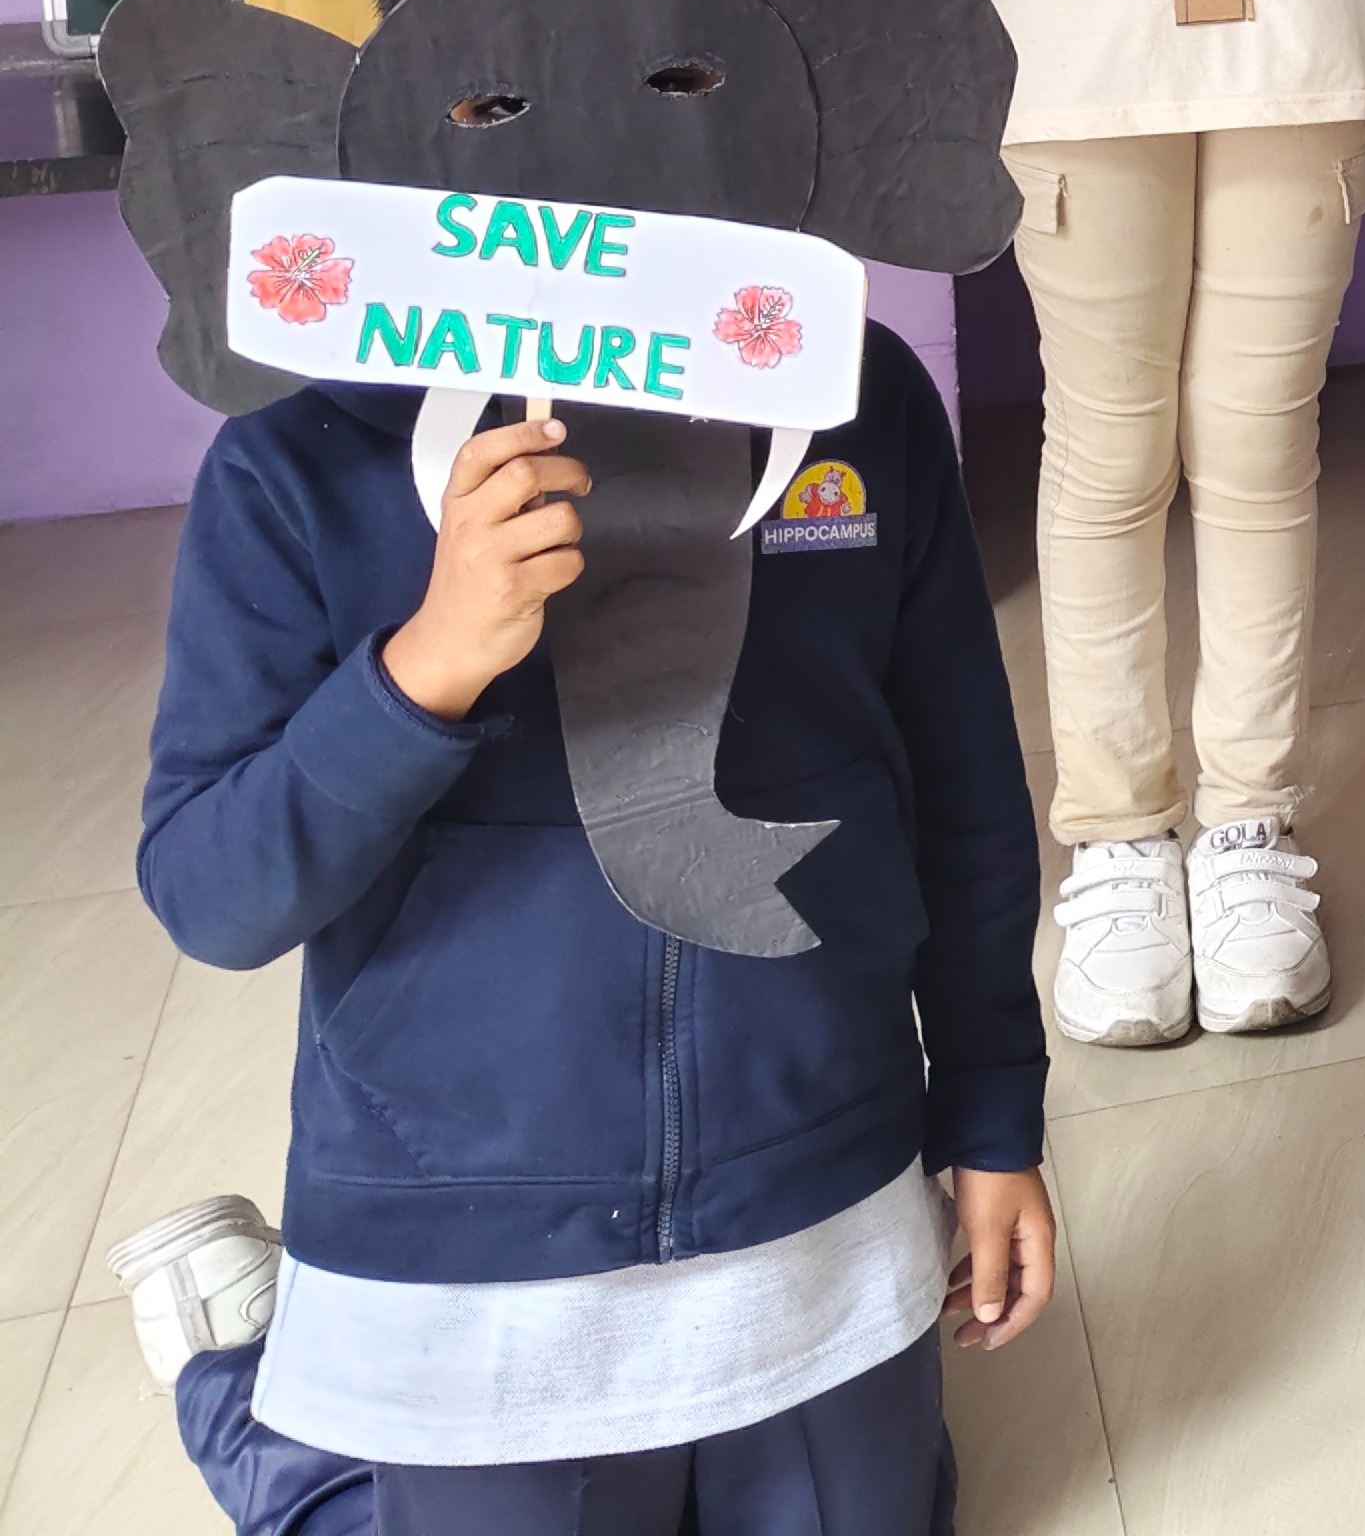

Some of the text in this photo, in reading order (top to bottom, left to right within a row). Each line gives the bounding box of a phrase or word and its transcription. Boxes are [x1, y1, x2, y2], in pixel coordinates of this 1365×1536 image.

[432, 192, 636, 278] SAVE
[355, 301, 691, 400] NATURE
[764, 522, 876, 545] HIPPOCAMPUS
[1210, 822, 1266, 850] GOLA
